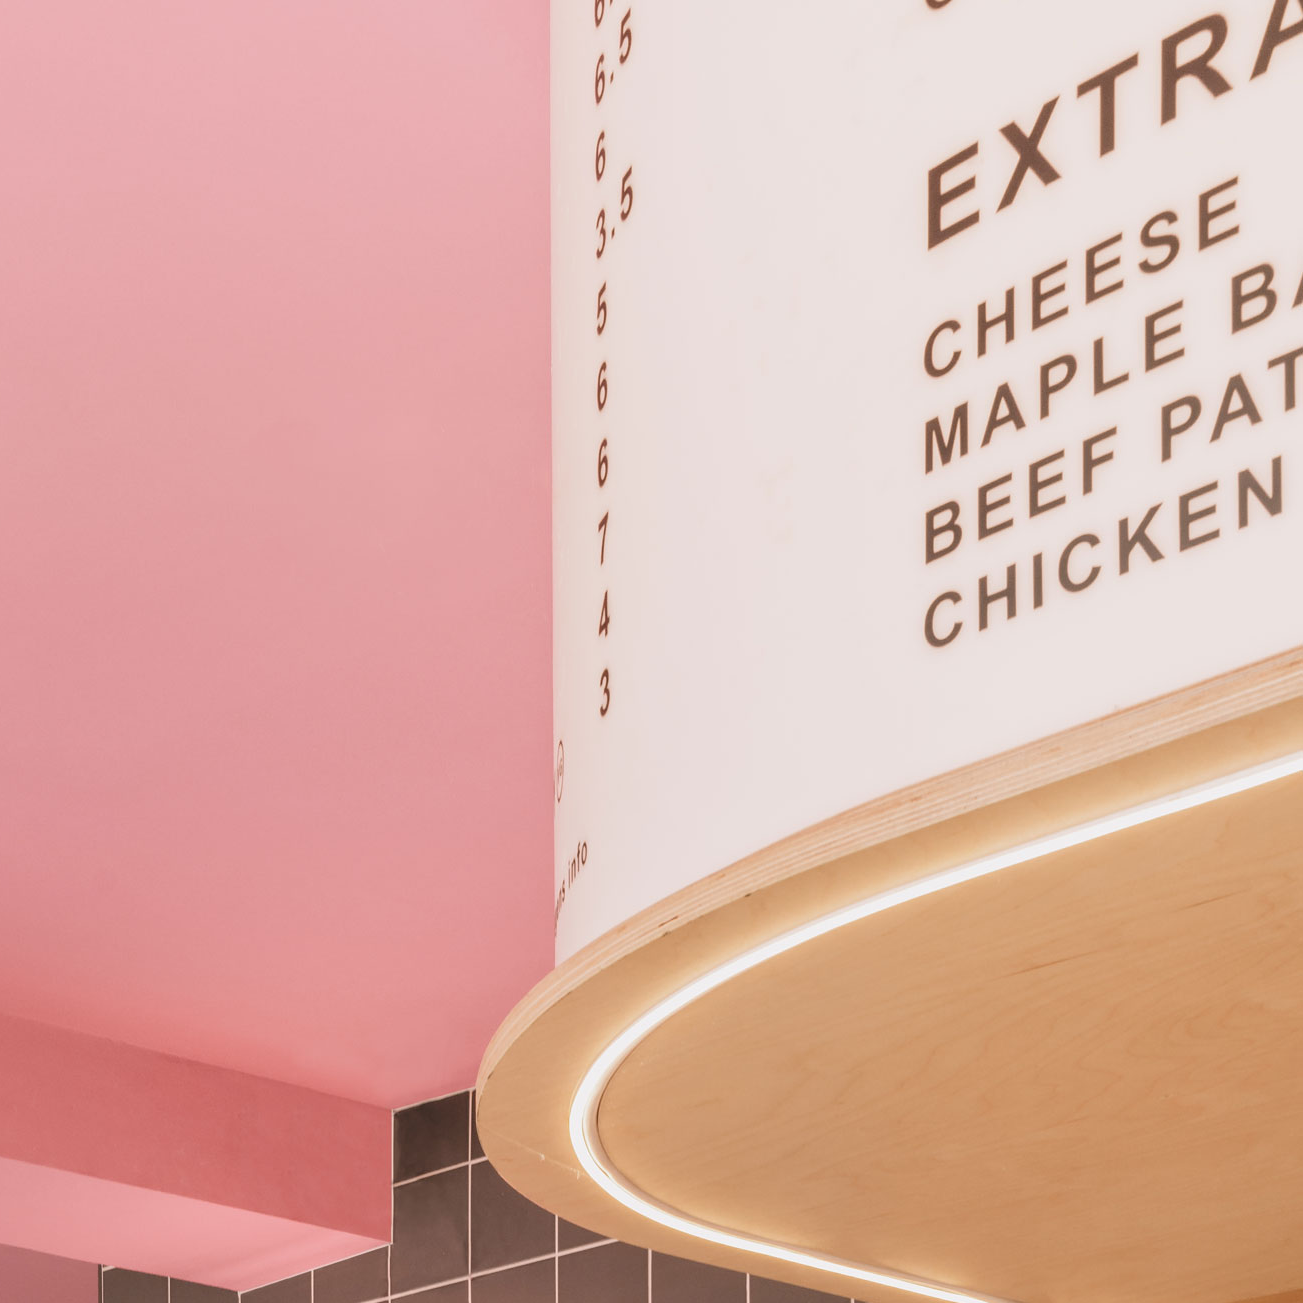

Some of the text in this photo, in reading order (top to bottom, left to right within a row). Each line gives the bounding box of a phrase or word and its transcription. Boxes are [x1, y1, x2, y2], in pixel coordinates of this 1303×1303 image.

[595, 8, 632, 105] 6.5
[595, 130, 606, 182] 6
[596, 165, 633, 260] 3.5
[924, 176, 1240, 378] CHEESE
[597, 282, 607, 336] 5
[597, 361, 607, 412] 6
[925, 263, 1303, 475] MAPLE B
[598, 438, 608, 489] 6
[925, 426, 1118, 564] BEEF
[598, 511, 608, 566] 7
[924, 455, 1283, 648] CHICKEN
[599, 589, 610, 639] 4
[599, 667, 610, 718] 3
[568, 841, 588, 889] info
